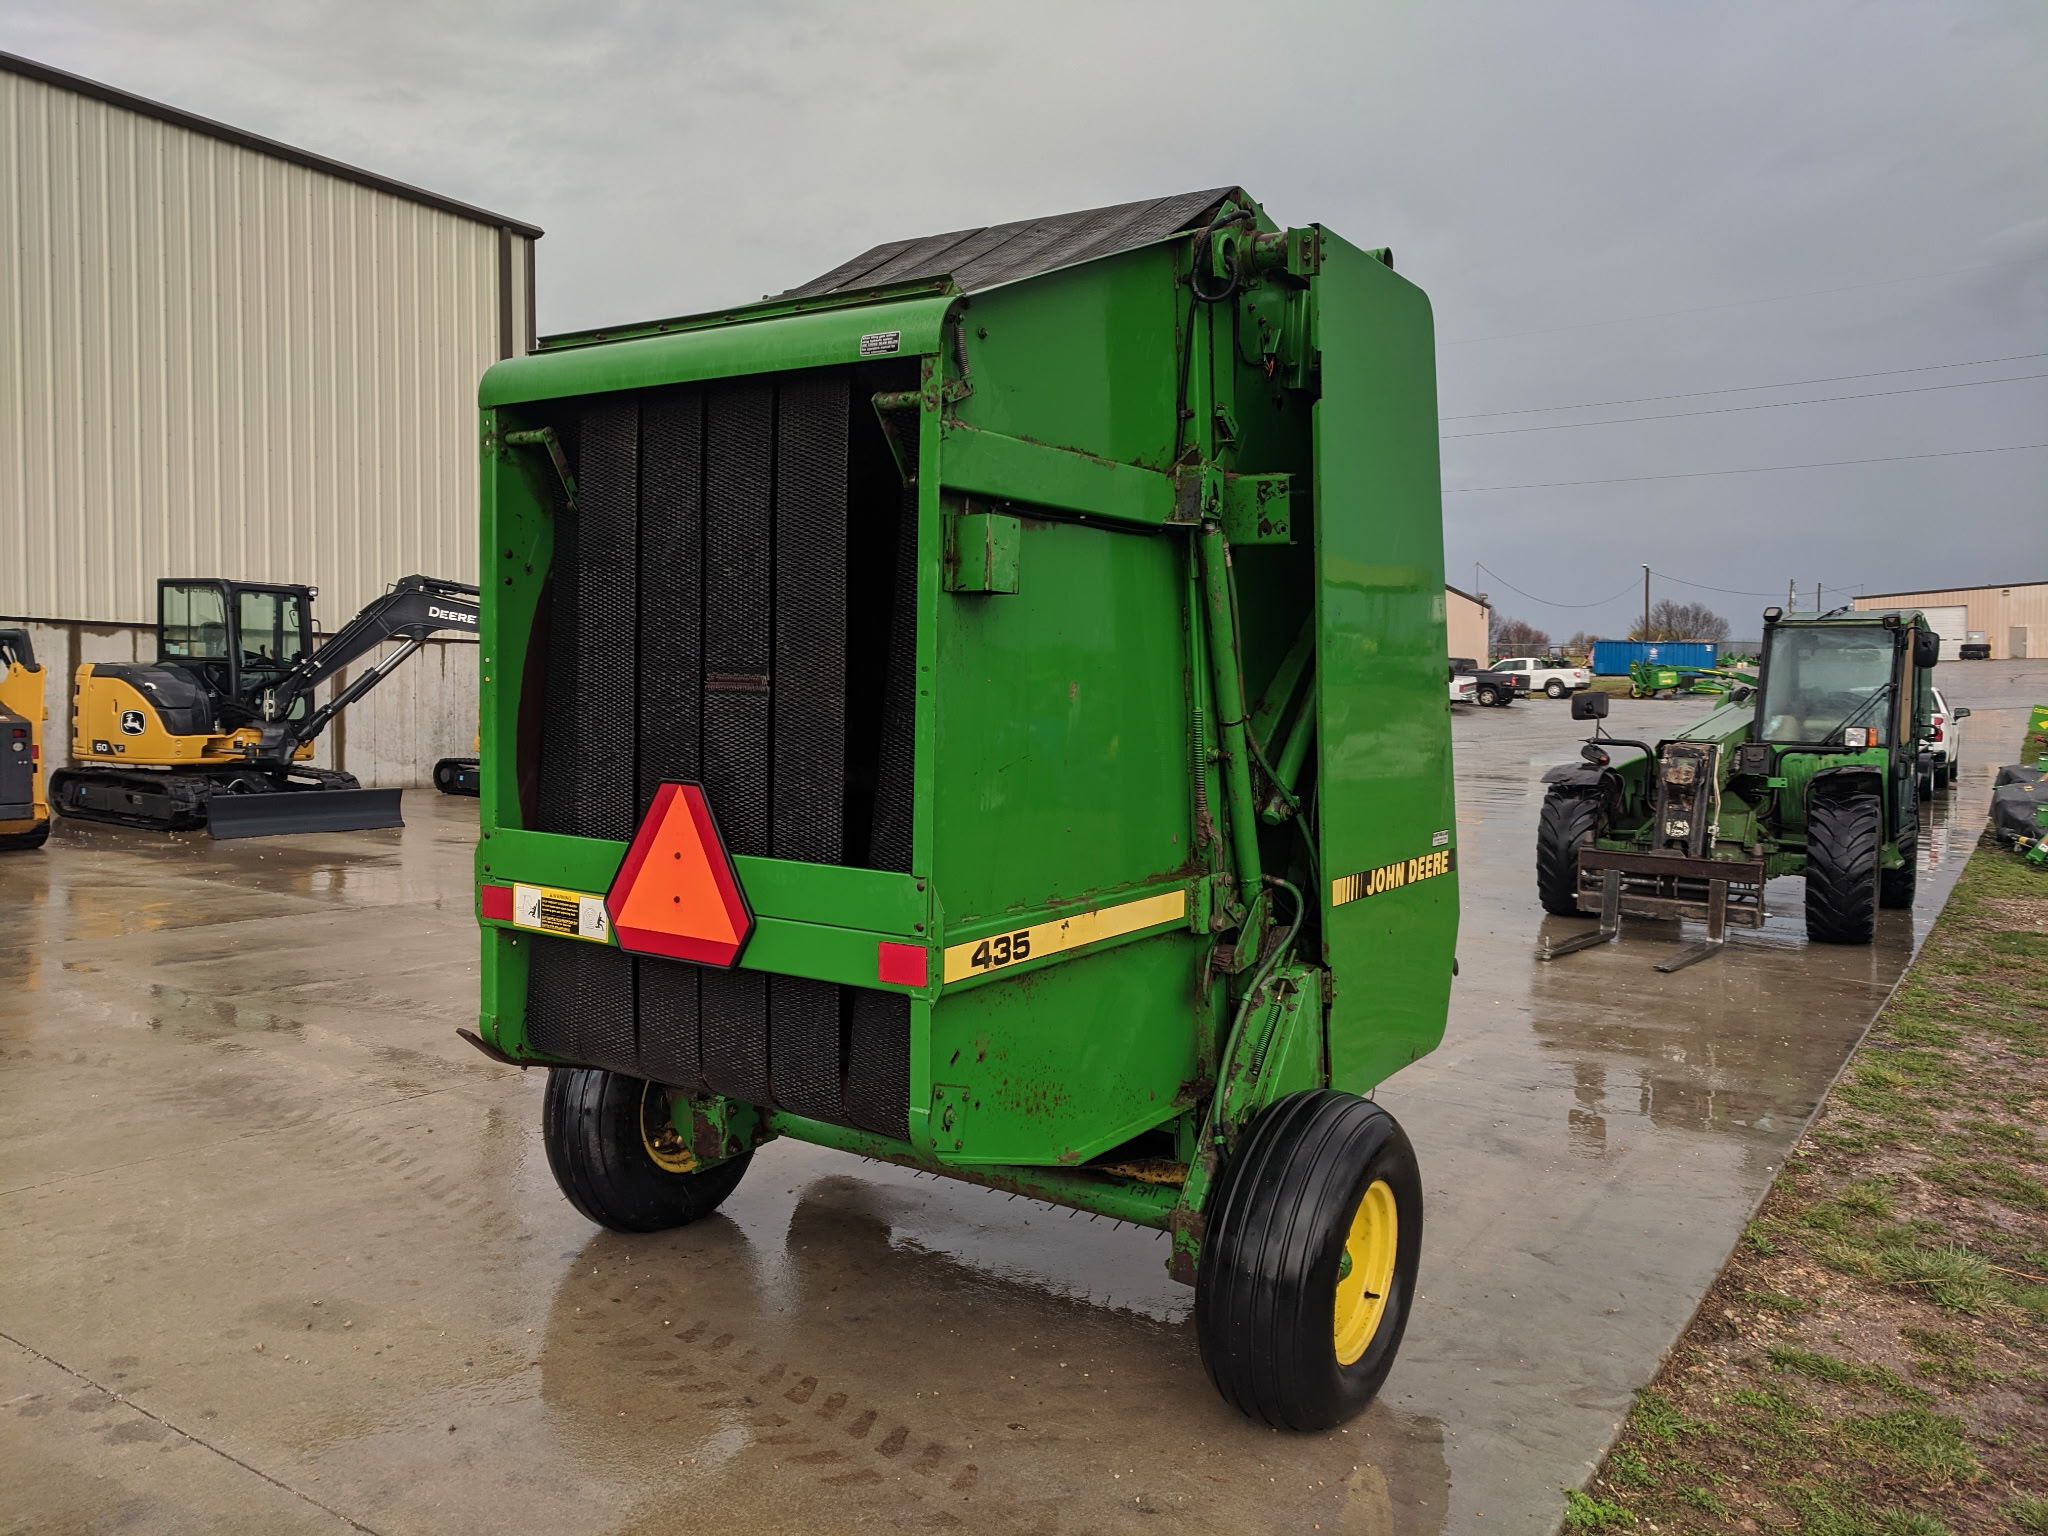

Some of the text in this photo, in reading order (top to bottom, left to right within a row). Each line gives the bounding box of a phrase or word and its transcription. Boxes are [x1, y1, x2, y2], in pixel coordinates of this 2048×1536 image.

[428, 606, 477, 624] DEERE
[96, 743, 108, 752] 60
[1366, 850, 1449, 896] JOHN DEERE
[971, 930, 1031, 970] 435
